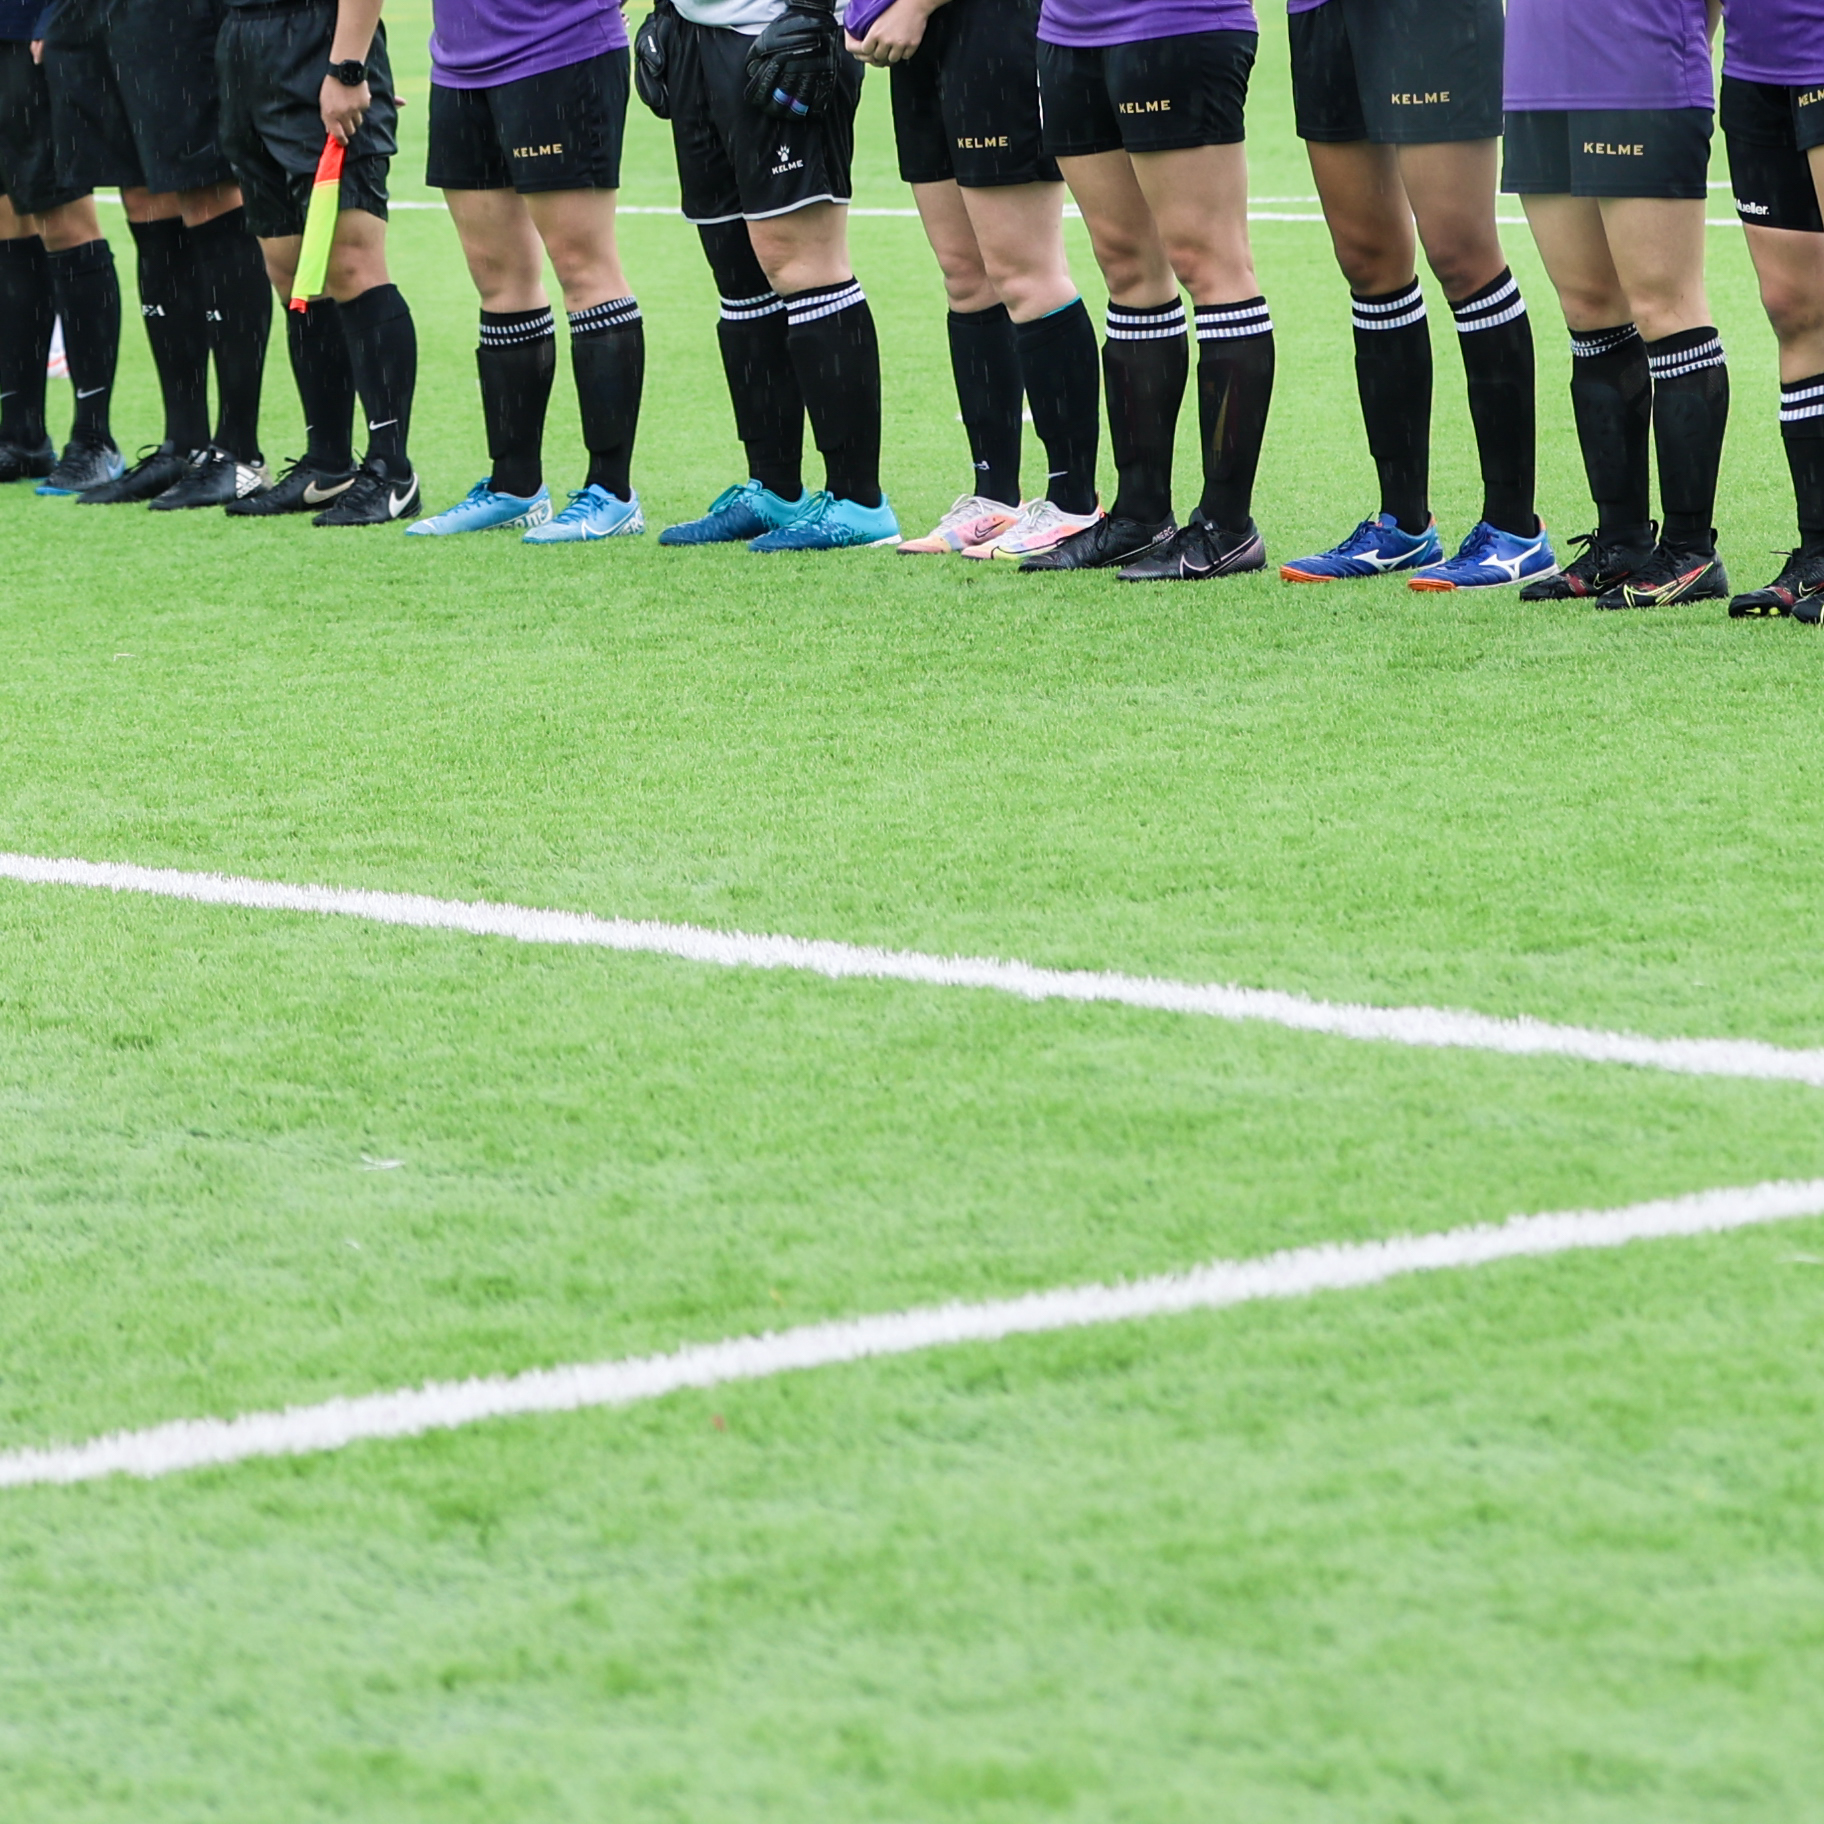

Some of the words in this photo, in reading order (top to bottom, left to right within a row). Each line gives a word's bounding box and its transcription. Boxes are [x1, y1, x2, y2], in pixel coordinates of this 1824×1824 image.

[1391, 91, 1451, 105] KELME
[1119, 99, 1172, 115] KELME
[512, 142, 564, 158] KELME
[957, 135, 1009, 150] KELME
[1583, 141, 1645, 156] KELME
[771, 159, 805, 176] KELME
